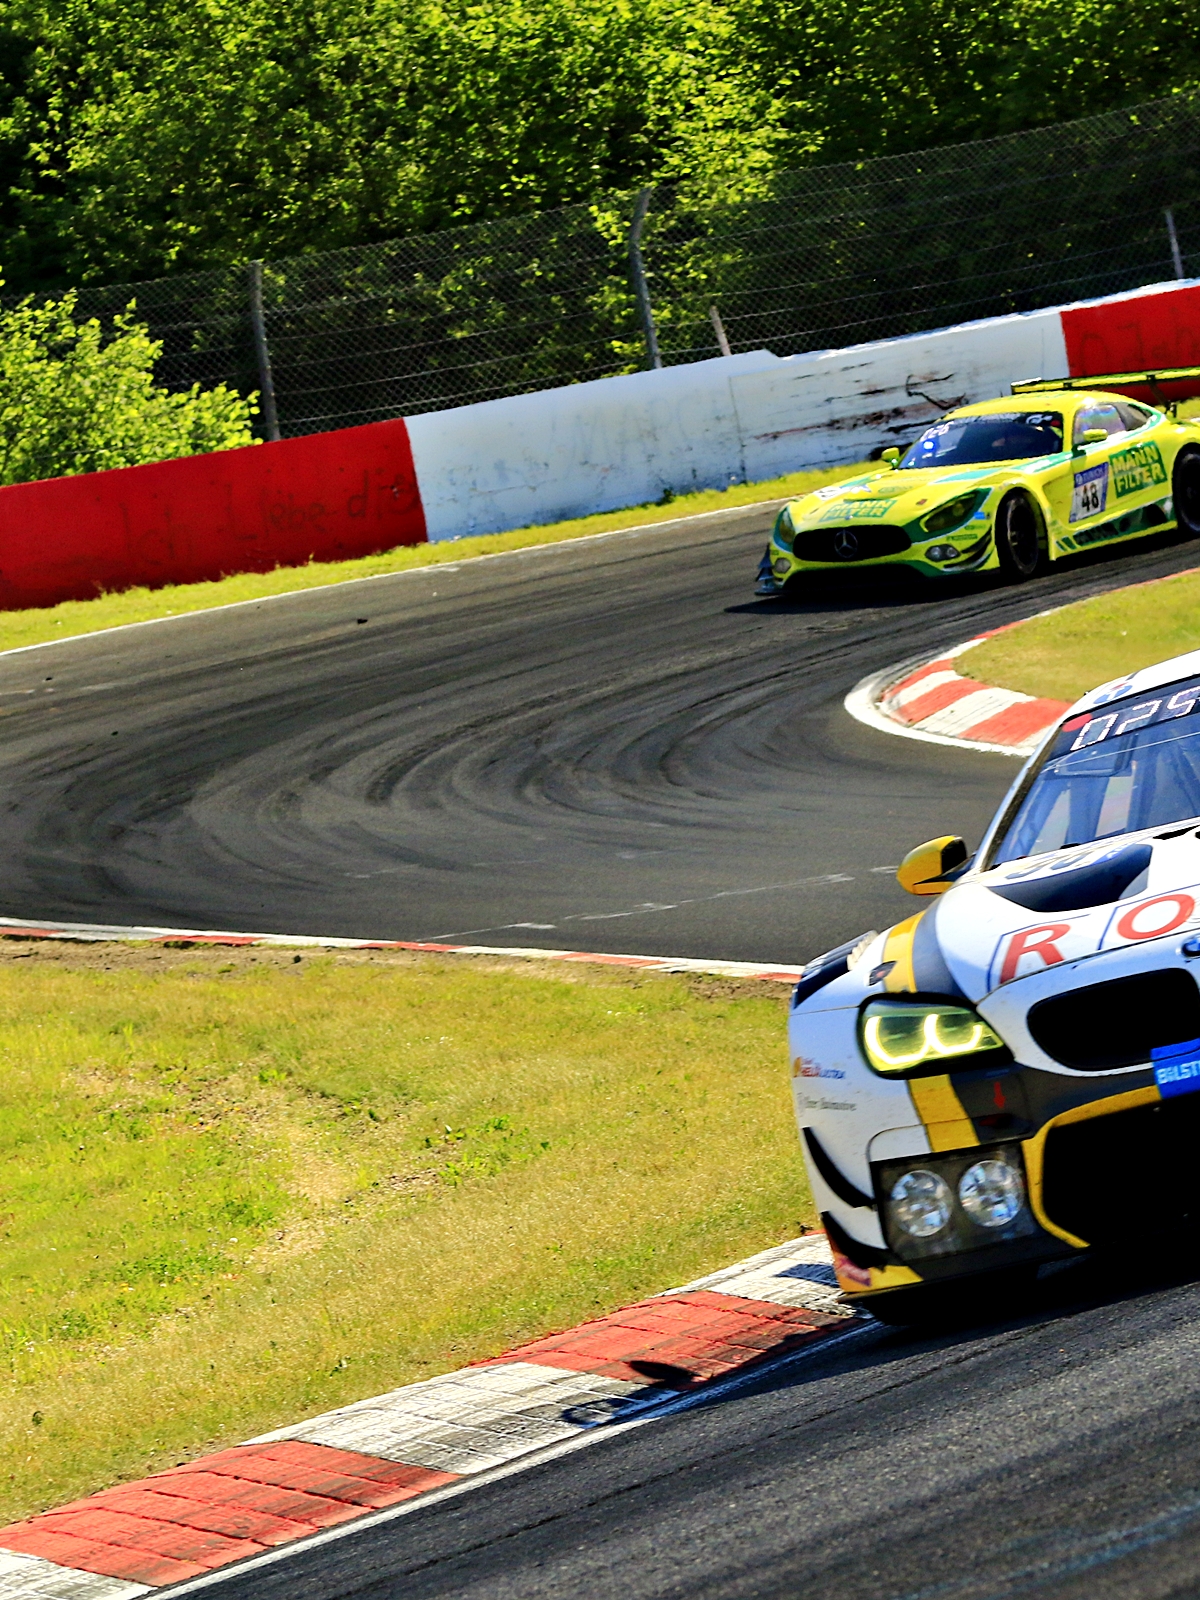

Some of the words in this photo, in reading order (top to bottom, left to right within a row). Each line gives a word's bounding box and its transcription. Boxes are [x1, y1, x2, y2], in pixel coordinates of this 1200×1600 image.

[1112, 445, 1159, 473] MANN
[1115, 463, 1165, 493] FILTER
[1081, 482, 1100, 513] 48
